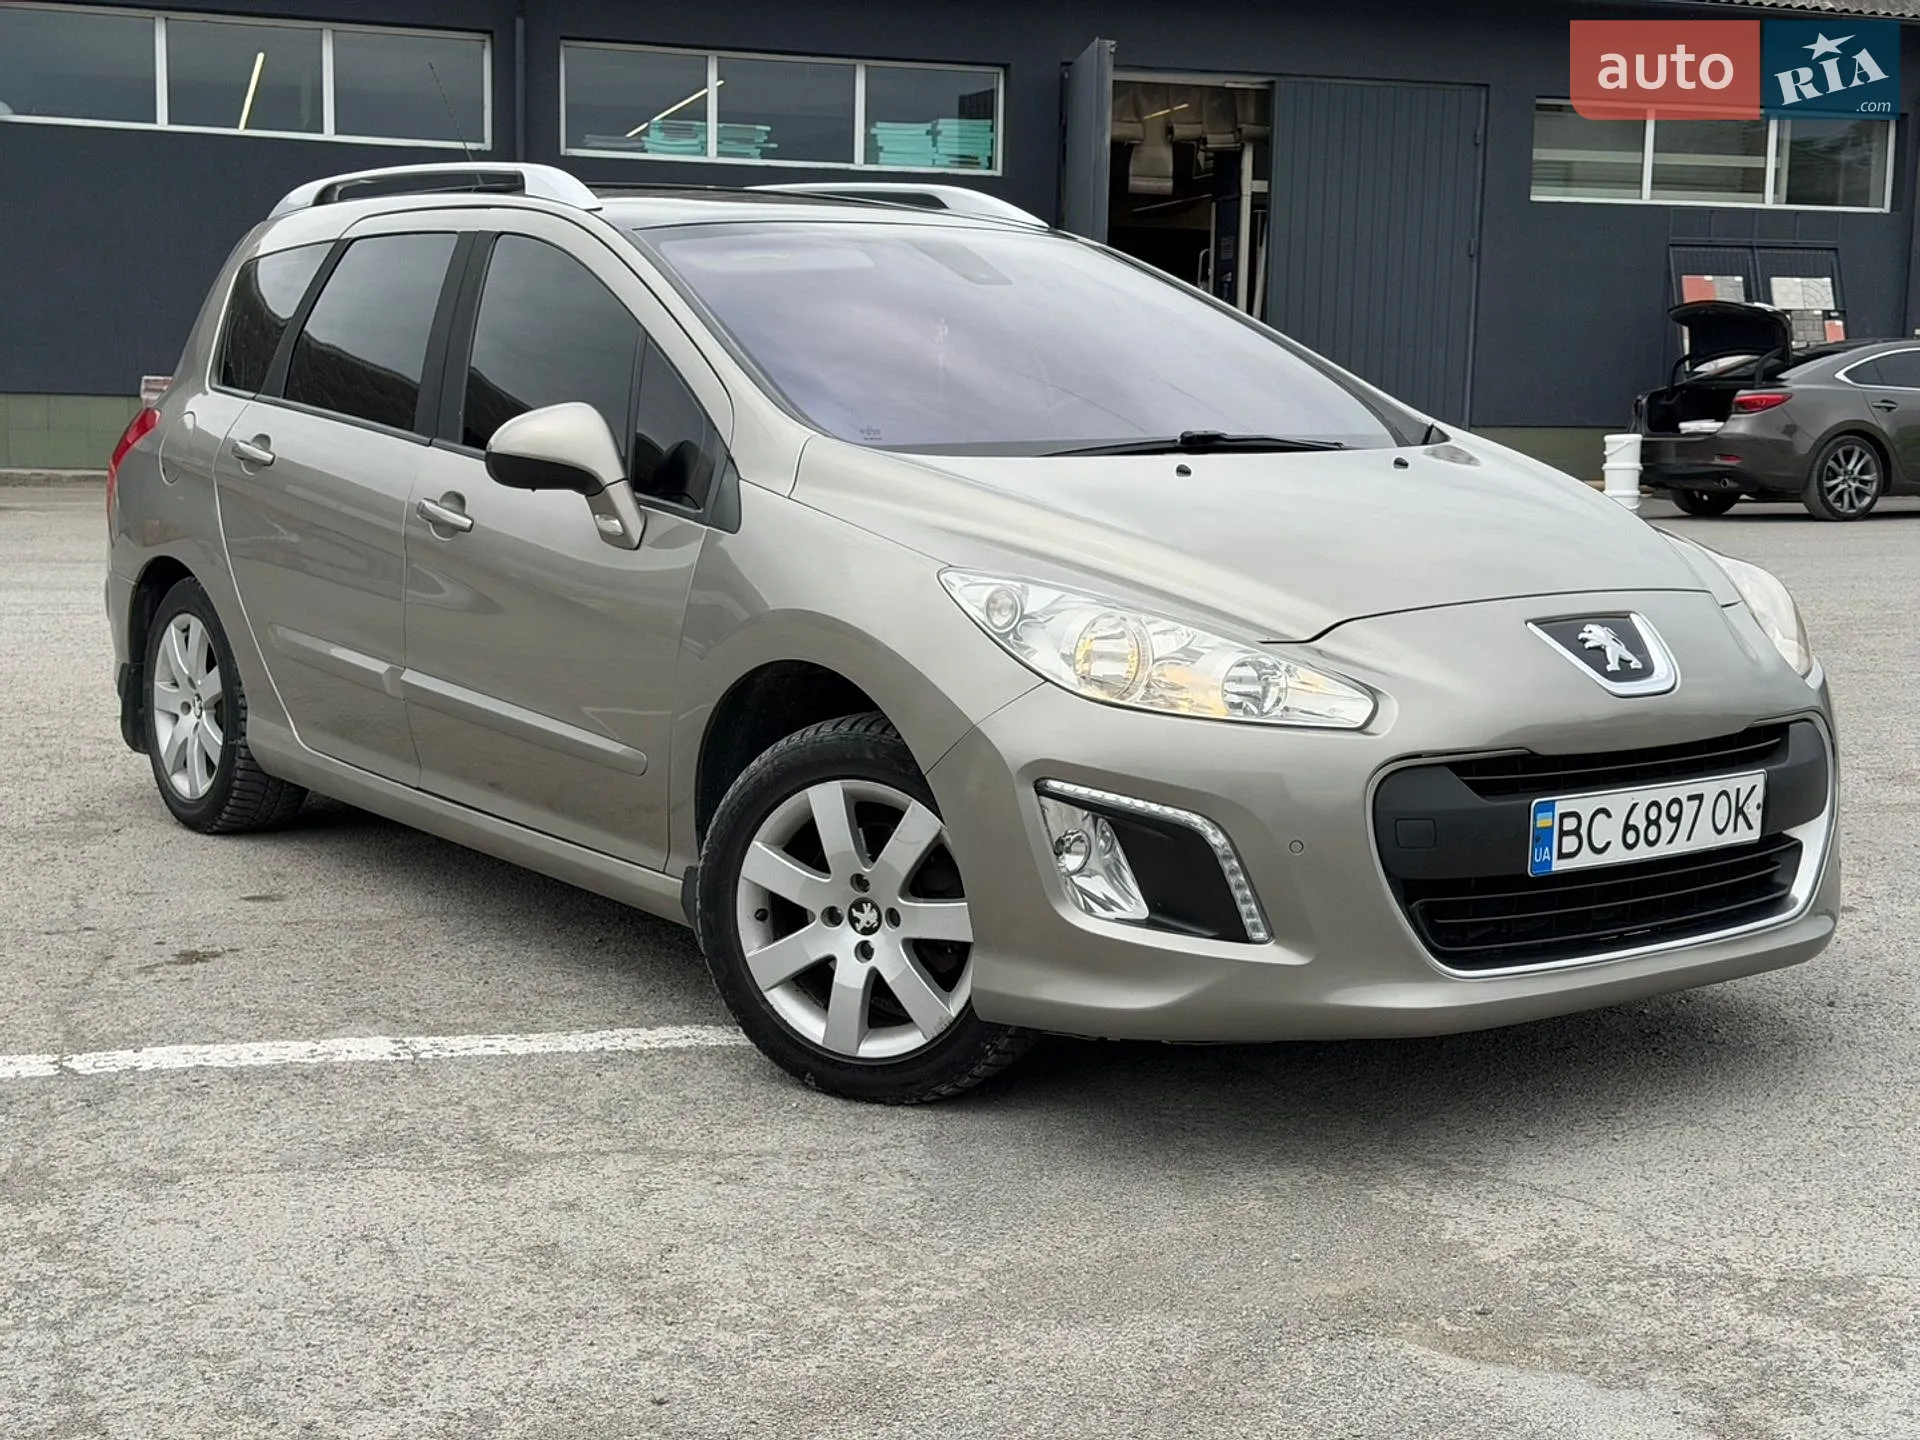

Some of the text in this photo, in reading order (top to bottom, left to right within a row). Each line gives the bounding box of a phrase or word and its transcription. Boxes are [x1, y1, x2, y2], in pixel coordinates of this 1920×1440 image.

[1557, 784, 1758, 860] BC 6897 OK
[1534, 847, 1551, 863] UA
